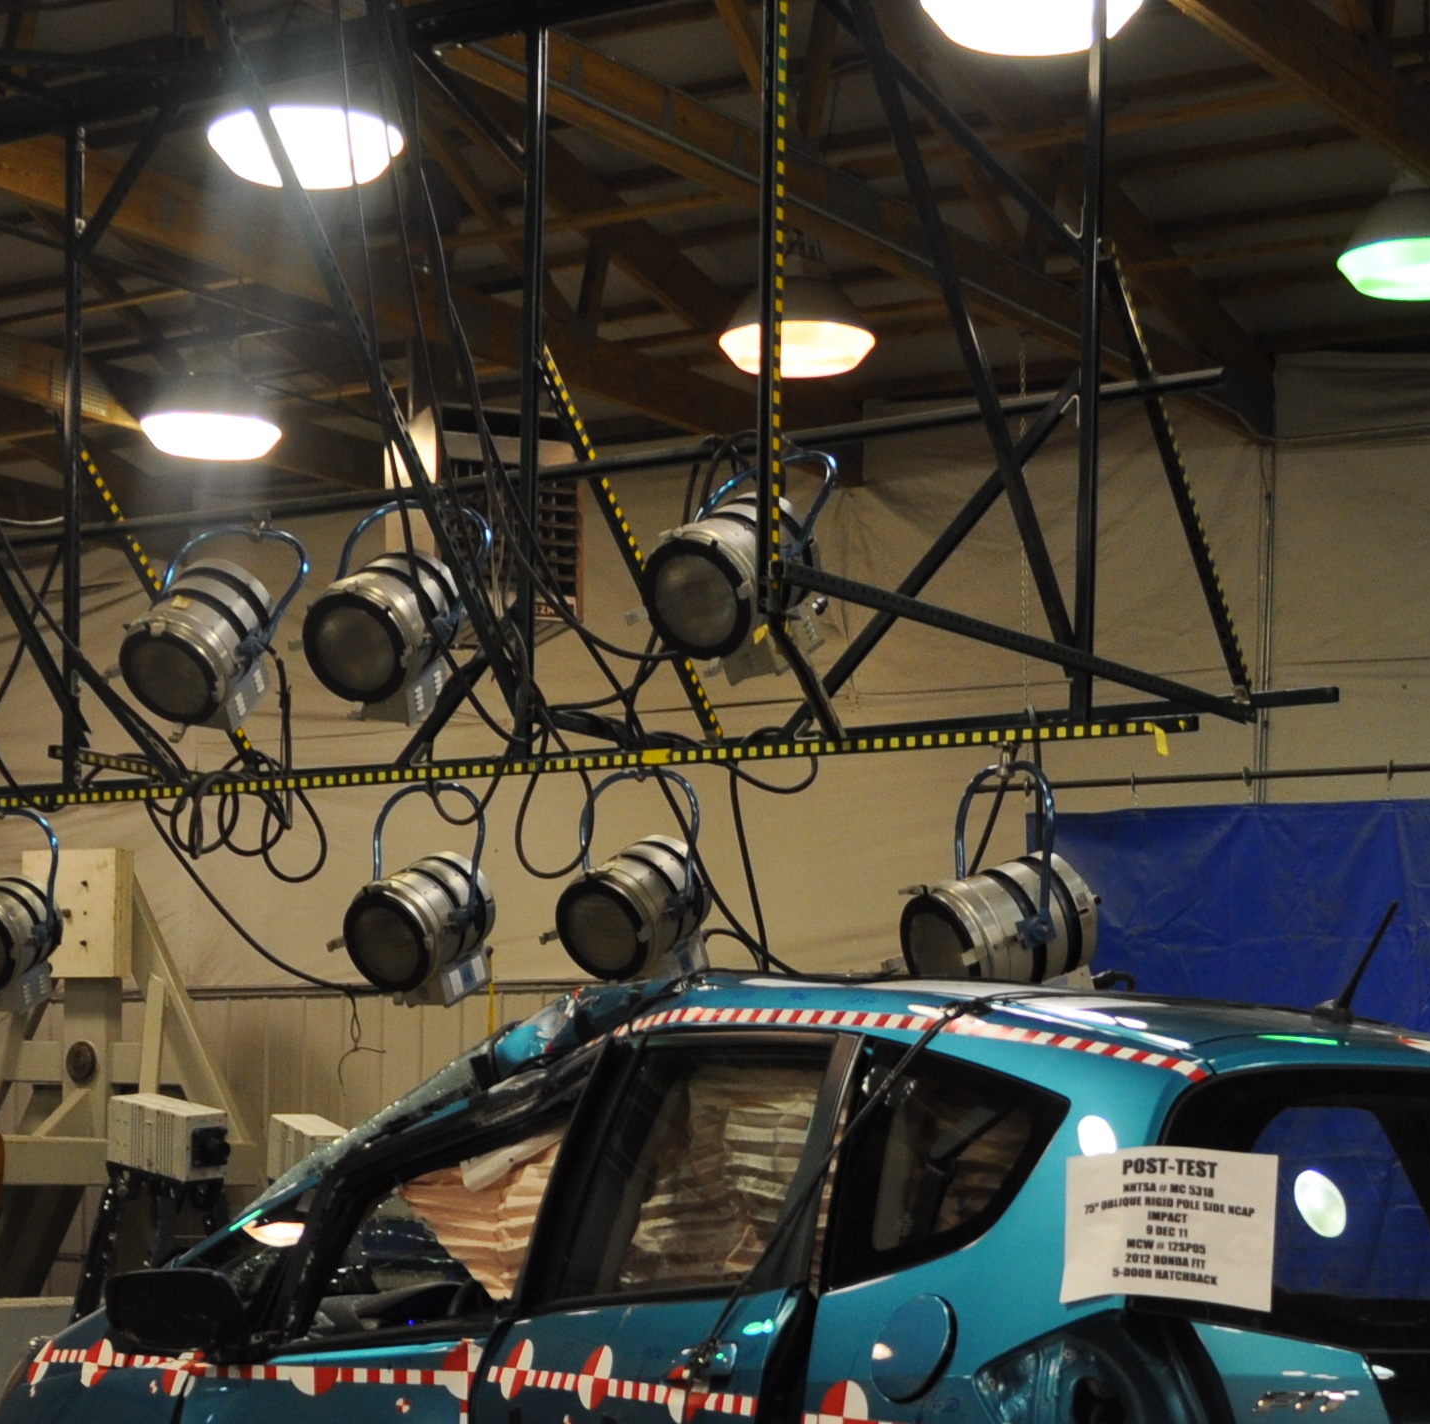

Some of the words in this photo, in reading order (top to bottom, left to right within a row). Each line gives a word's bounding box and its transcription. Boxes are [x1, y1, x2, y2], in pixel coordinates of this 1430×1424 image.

[1122, 1158, 1218, 1179] POST-TEST
[1123, 1182, 1156, 1193] NHTSA
[1159, 1183, 1167, 1192] #
[1170, 1183, 1186, 1194] MC
[1188, 1185, 1214, 1198] 5318
[1101, 1196, 1141, 1210] OBLIQUE
[1145, 1196, 1173, 1207] RIGID
[1177, 1197, 1200, 1210] POLE
[1203, 1201, 1225, 1214] SIDE
[1228, 1205, 1255, 1217] NCAP
[1147, 1211, 1188, 1224] IMPACT
[1146, 1225, 1153, 1235] 9
[1156, 1226, 1175, 1237] DEC
[1179, 1228, 1188, 1238] 11
[1127, 1239, 1154, 1250] MCW
[1125, 1253, 1150, 1264] 2012
[1153, 1254, 1189, 1268] HONDA
[1191, 1258, 1206, 1269] FIT
[1113, 1267, 1152, 1278] 5-DOOR
[1155, 1270, 1218, 1286] HATCHBACK
